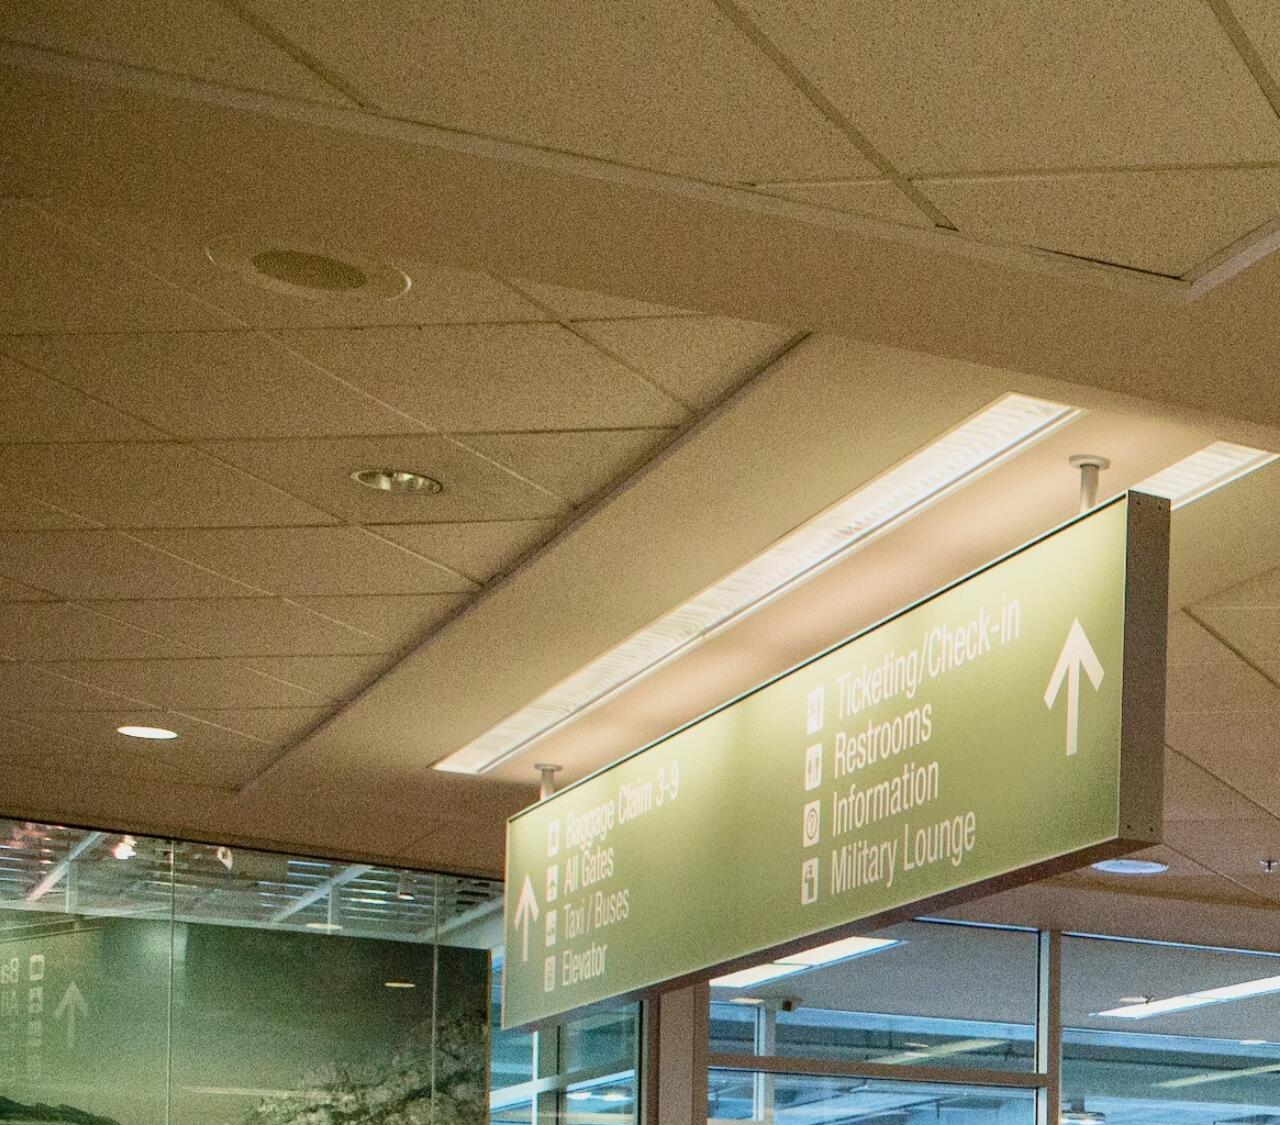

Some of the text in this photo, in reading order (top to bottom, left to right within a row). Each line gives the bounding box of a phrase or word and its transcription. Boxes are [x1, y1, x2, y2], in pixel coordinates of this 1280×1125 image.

[836, 594, 1021, 720] Ticketing/Check-in
[834, 703, 932, 779] Restrooms
[566, 759, 680, 850] Baggage Claim 3-9
[832, 761, 939, 837] Information
[564, 846, 614, 896] All Gates
[831, 811, 976, 895] Military Lounge
[563, 897, 585, 940] Taxi
[595, 888, 630, 929] Buses
[562, 942, 608, 986] Elevator
